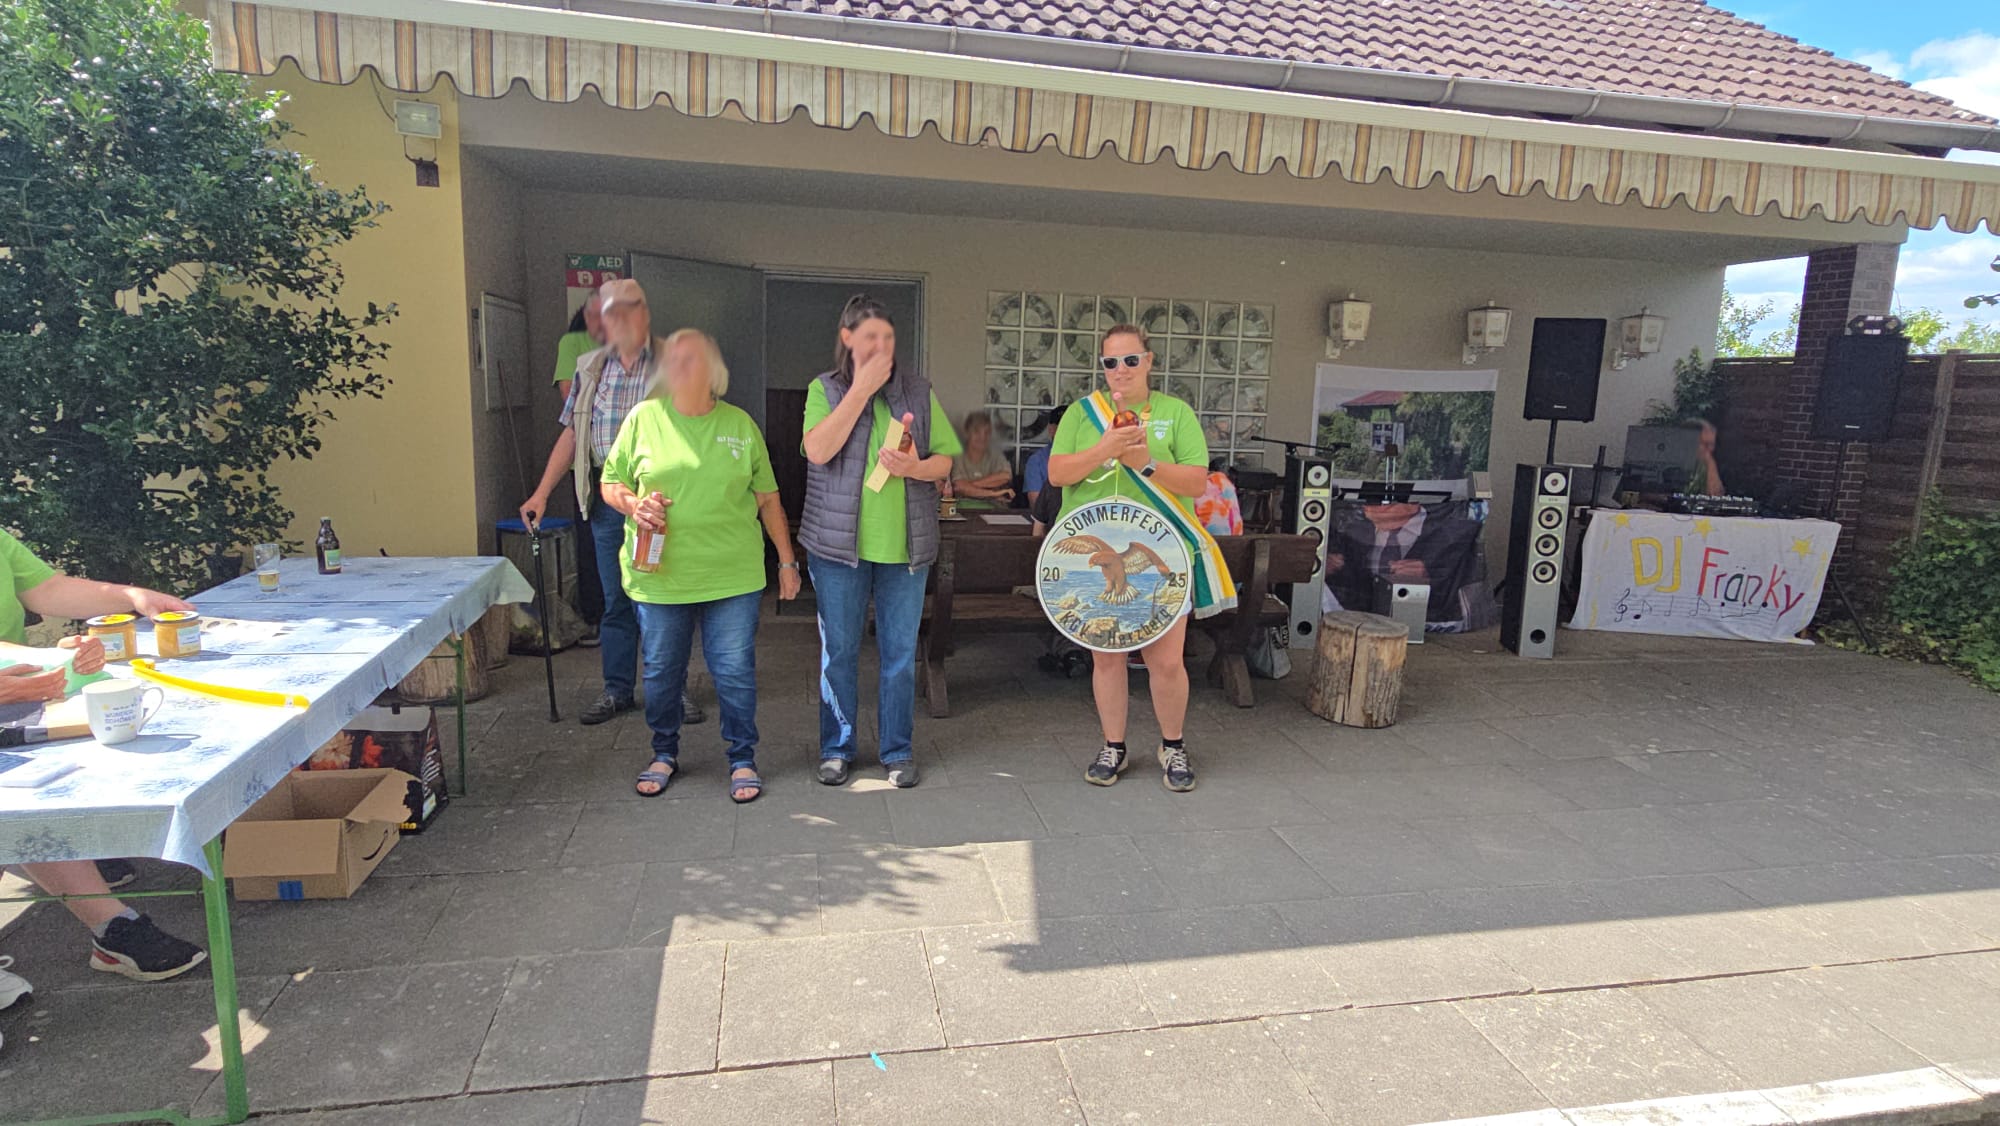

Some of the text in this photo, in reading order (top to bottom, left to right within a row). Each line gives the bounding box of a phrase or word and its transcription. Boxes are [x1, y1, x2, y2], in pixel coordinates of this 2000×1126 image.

[596, 256, 624, 268] AED
[1063, 506, 1171, 542] SOMMERFEST
[1042, 567, 1187, 588] 20 25
[1631, 536, 1682, 593] DJ
